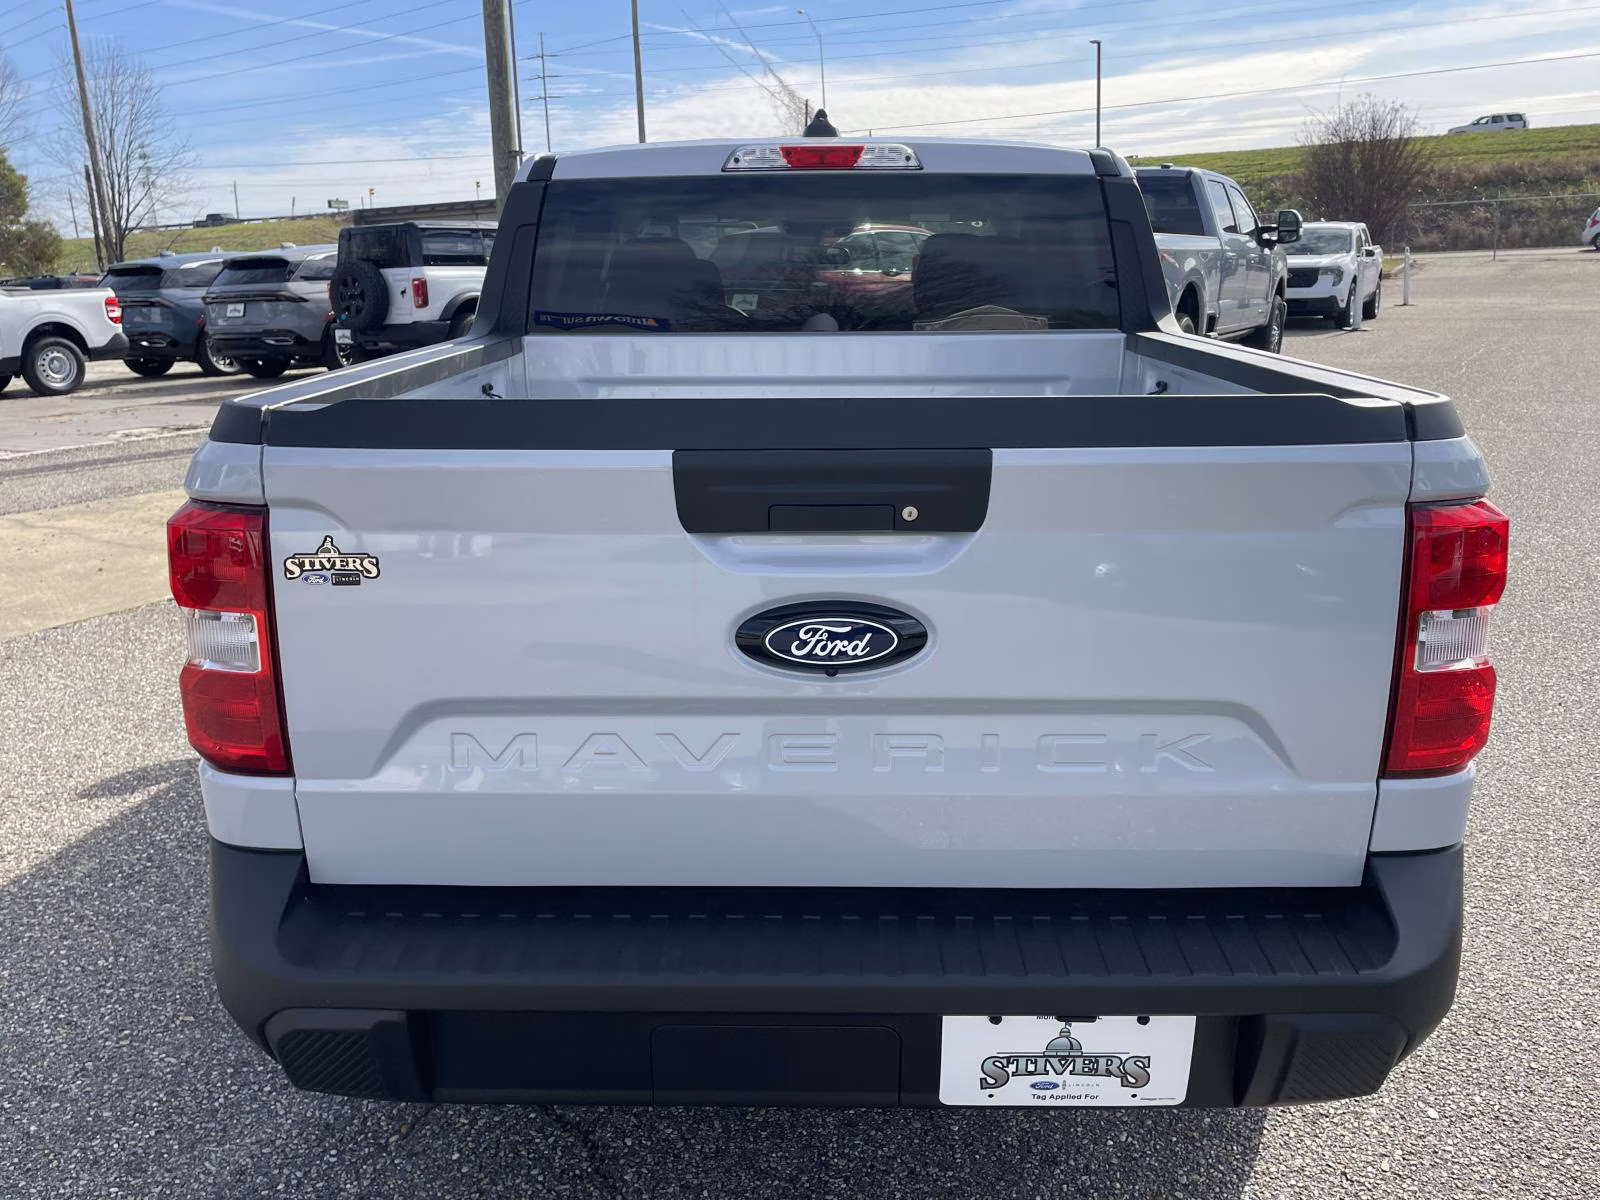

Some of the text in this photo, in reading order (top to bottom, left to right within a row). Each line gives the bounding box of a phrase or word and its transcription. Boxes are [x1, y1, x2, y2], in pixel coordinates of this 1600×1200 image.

[285, 557, 379, 579] STIVERS
[791, 624, 872, 656] Ford
[450, 732, 1214, 773] MAVERICK
[980, 1055, 1151, 1090] STIVERS
[1032, 1093, 1047, 1101] Tag
[1049, 1093, 1082, 1101] Applied
